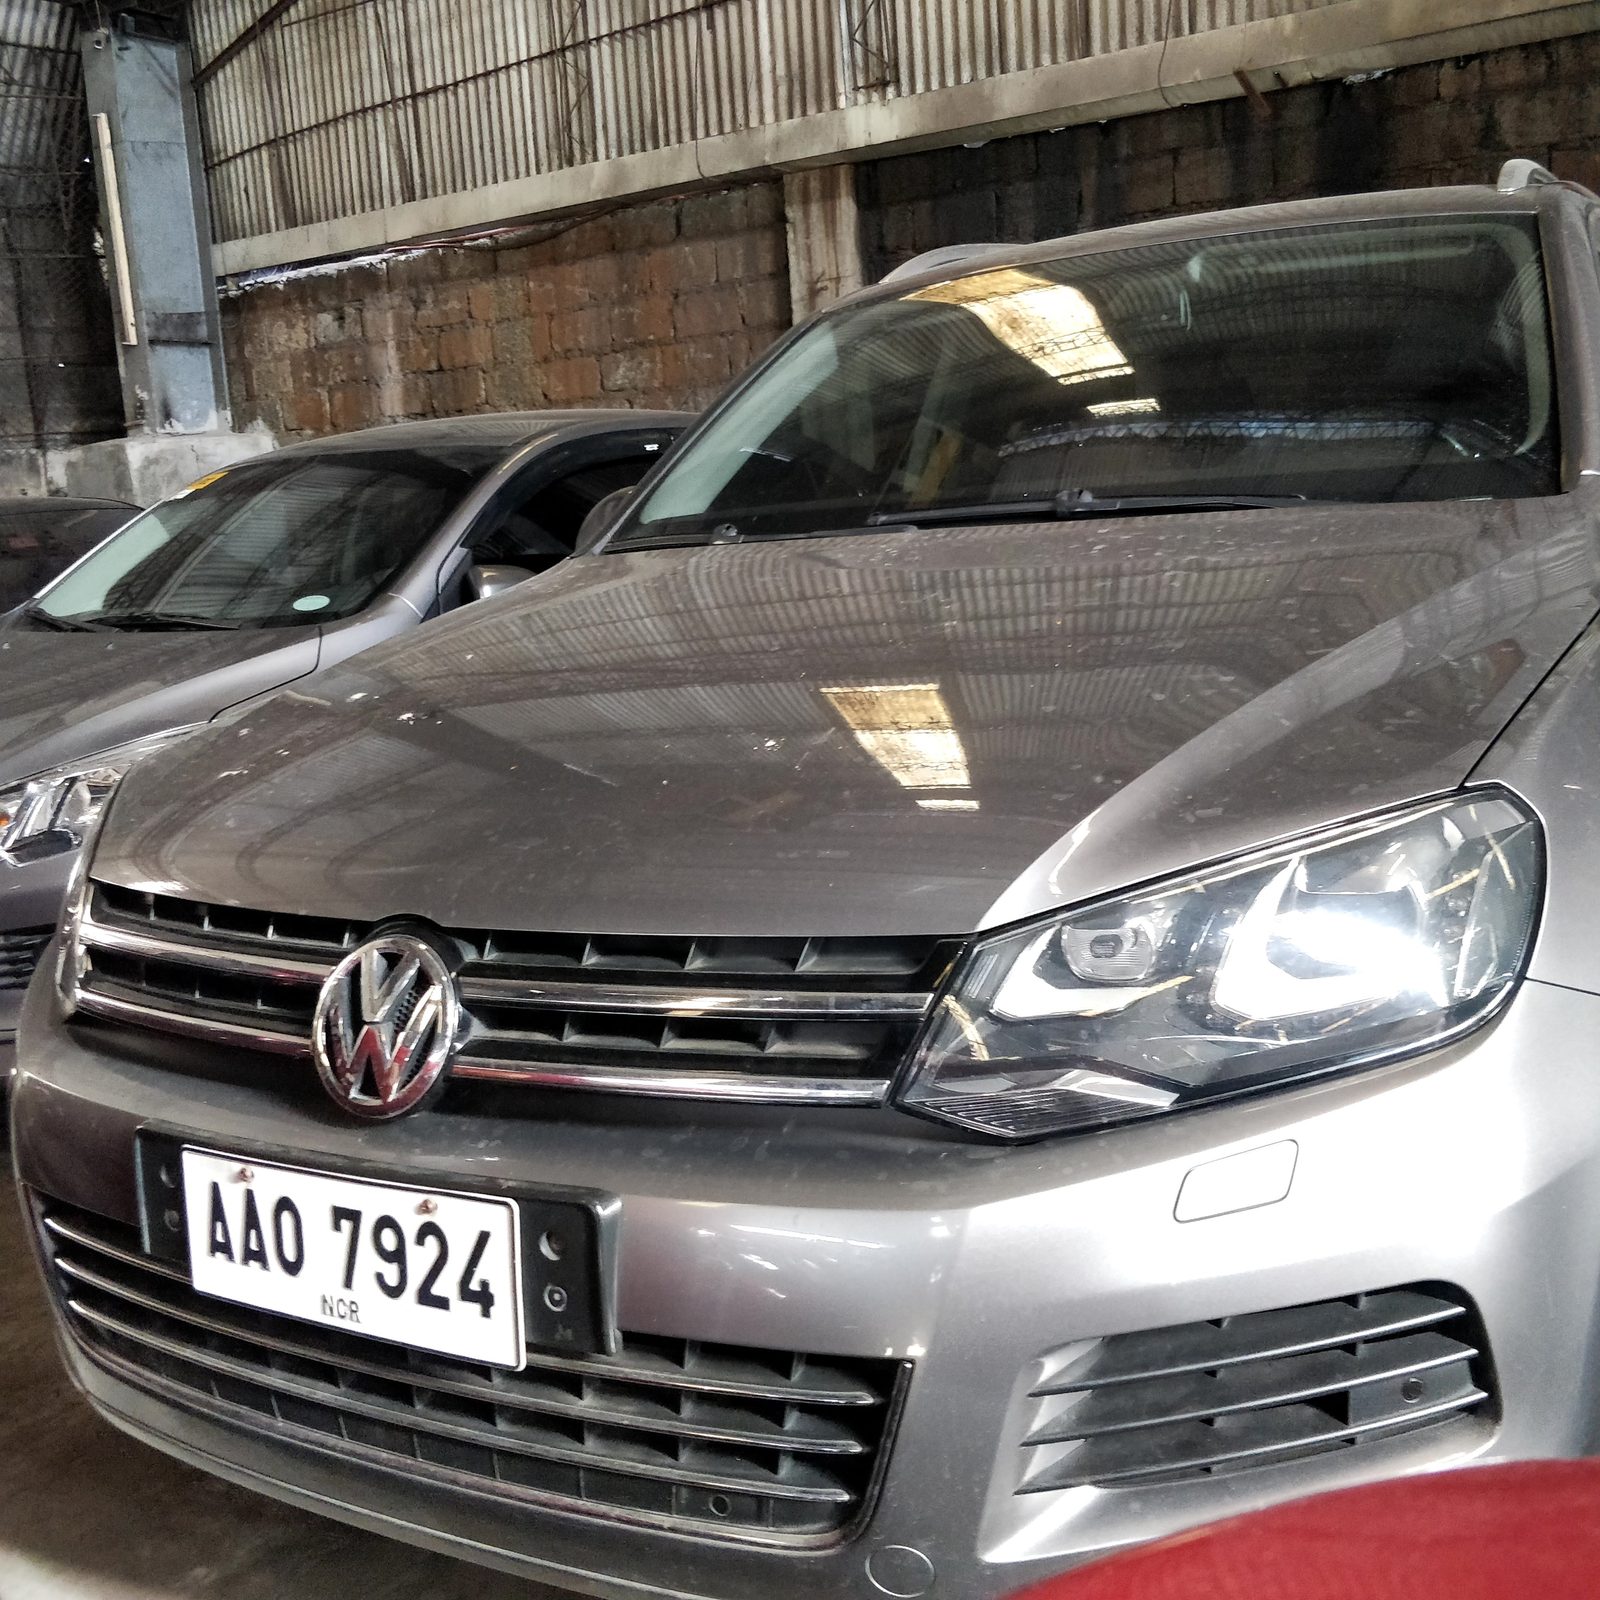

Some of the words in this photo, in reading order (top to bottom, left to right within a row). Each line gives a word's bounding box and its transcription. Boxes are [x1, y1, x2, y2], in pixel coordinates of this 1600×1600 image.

[208, 1180, 304, 1277] AAO
[331, 1204, 495, 1318] 7924
[321, 1294, 361, 1324] NCR
